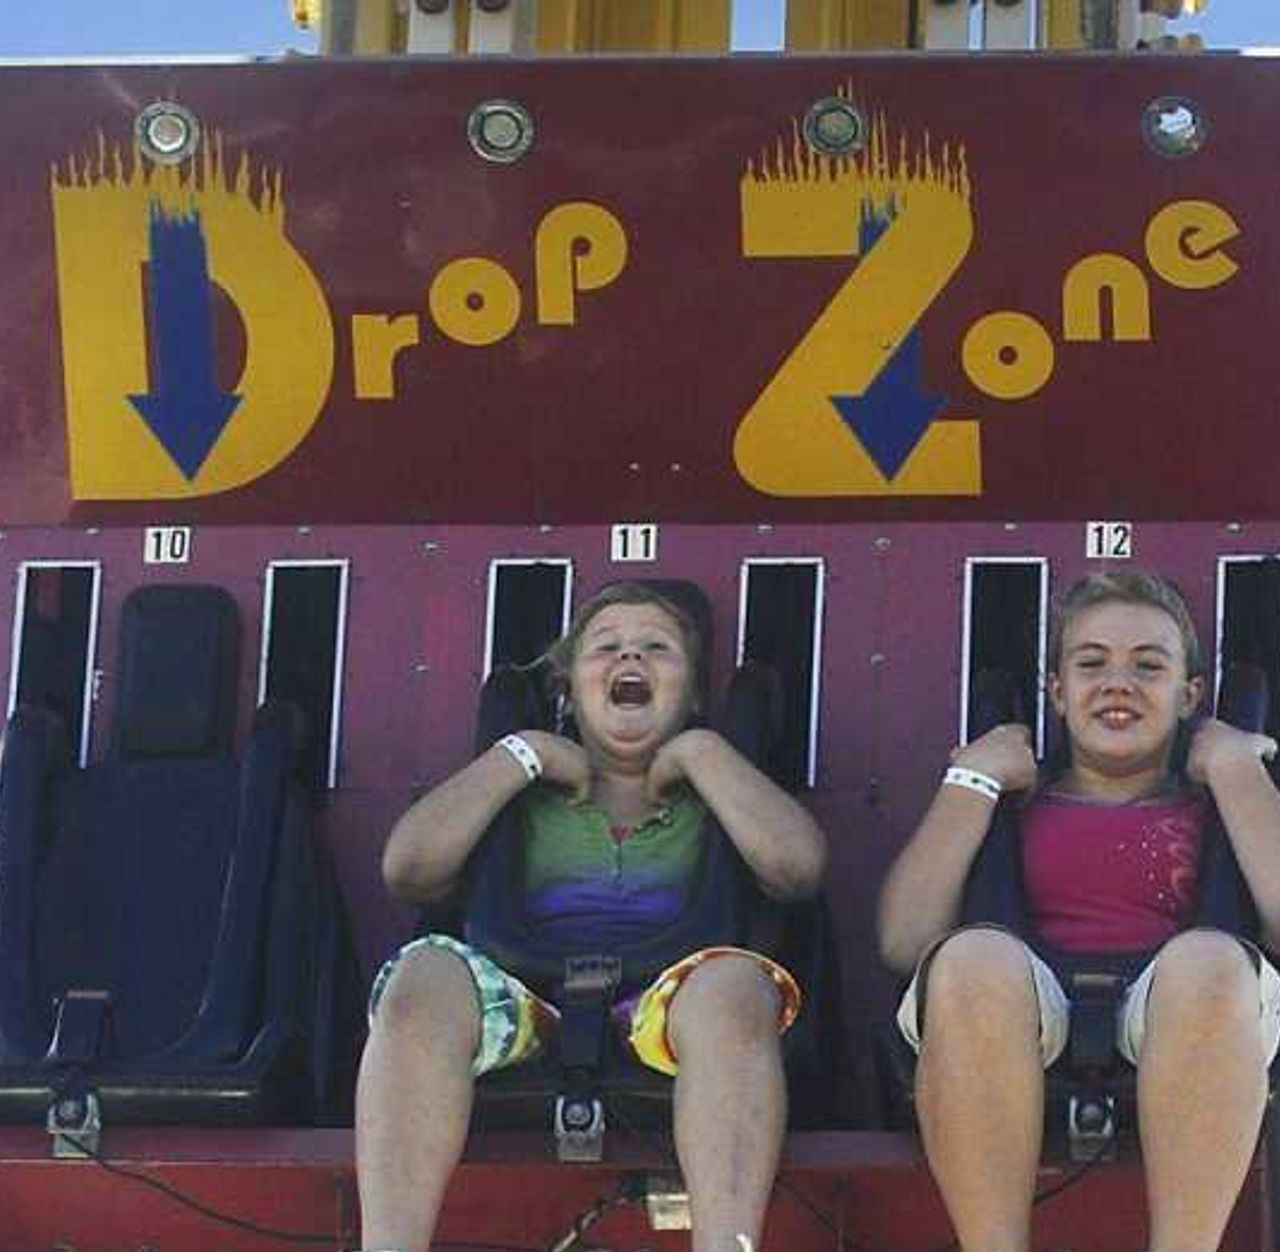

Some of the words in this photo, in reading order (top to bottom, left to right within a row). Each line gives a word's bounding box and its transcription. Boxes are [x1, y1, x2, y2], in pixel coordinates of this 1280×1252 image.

[51, 140, 628, 502] Drop
[732, 125, 1238, 498] Zone
[151, 530, 186, 560] 10
[618, 527, 651, 558] 11
[1093, 525, 1128, 556] 12
